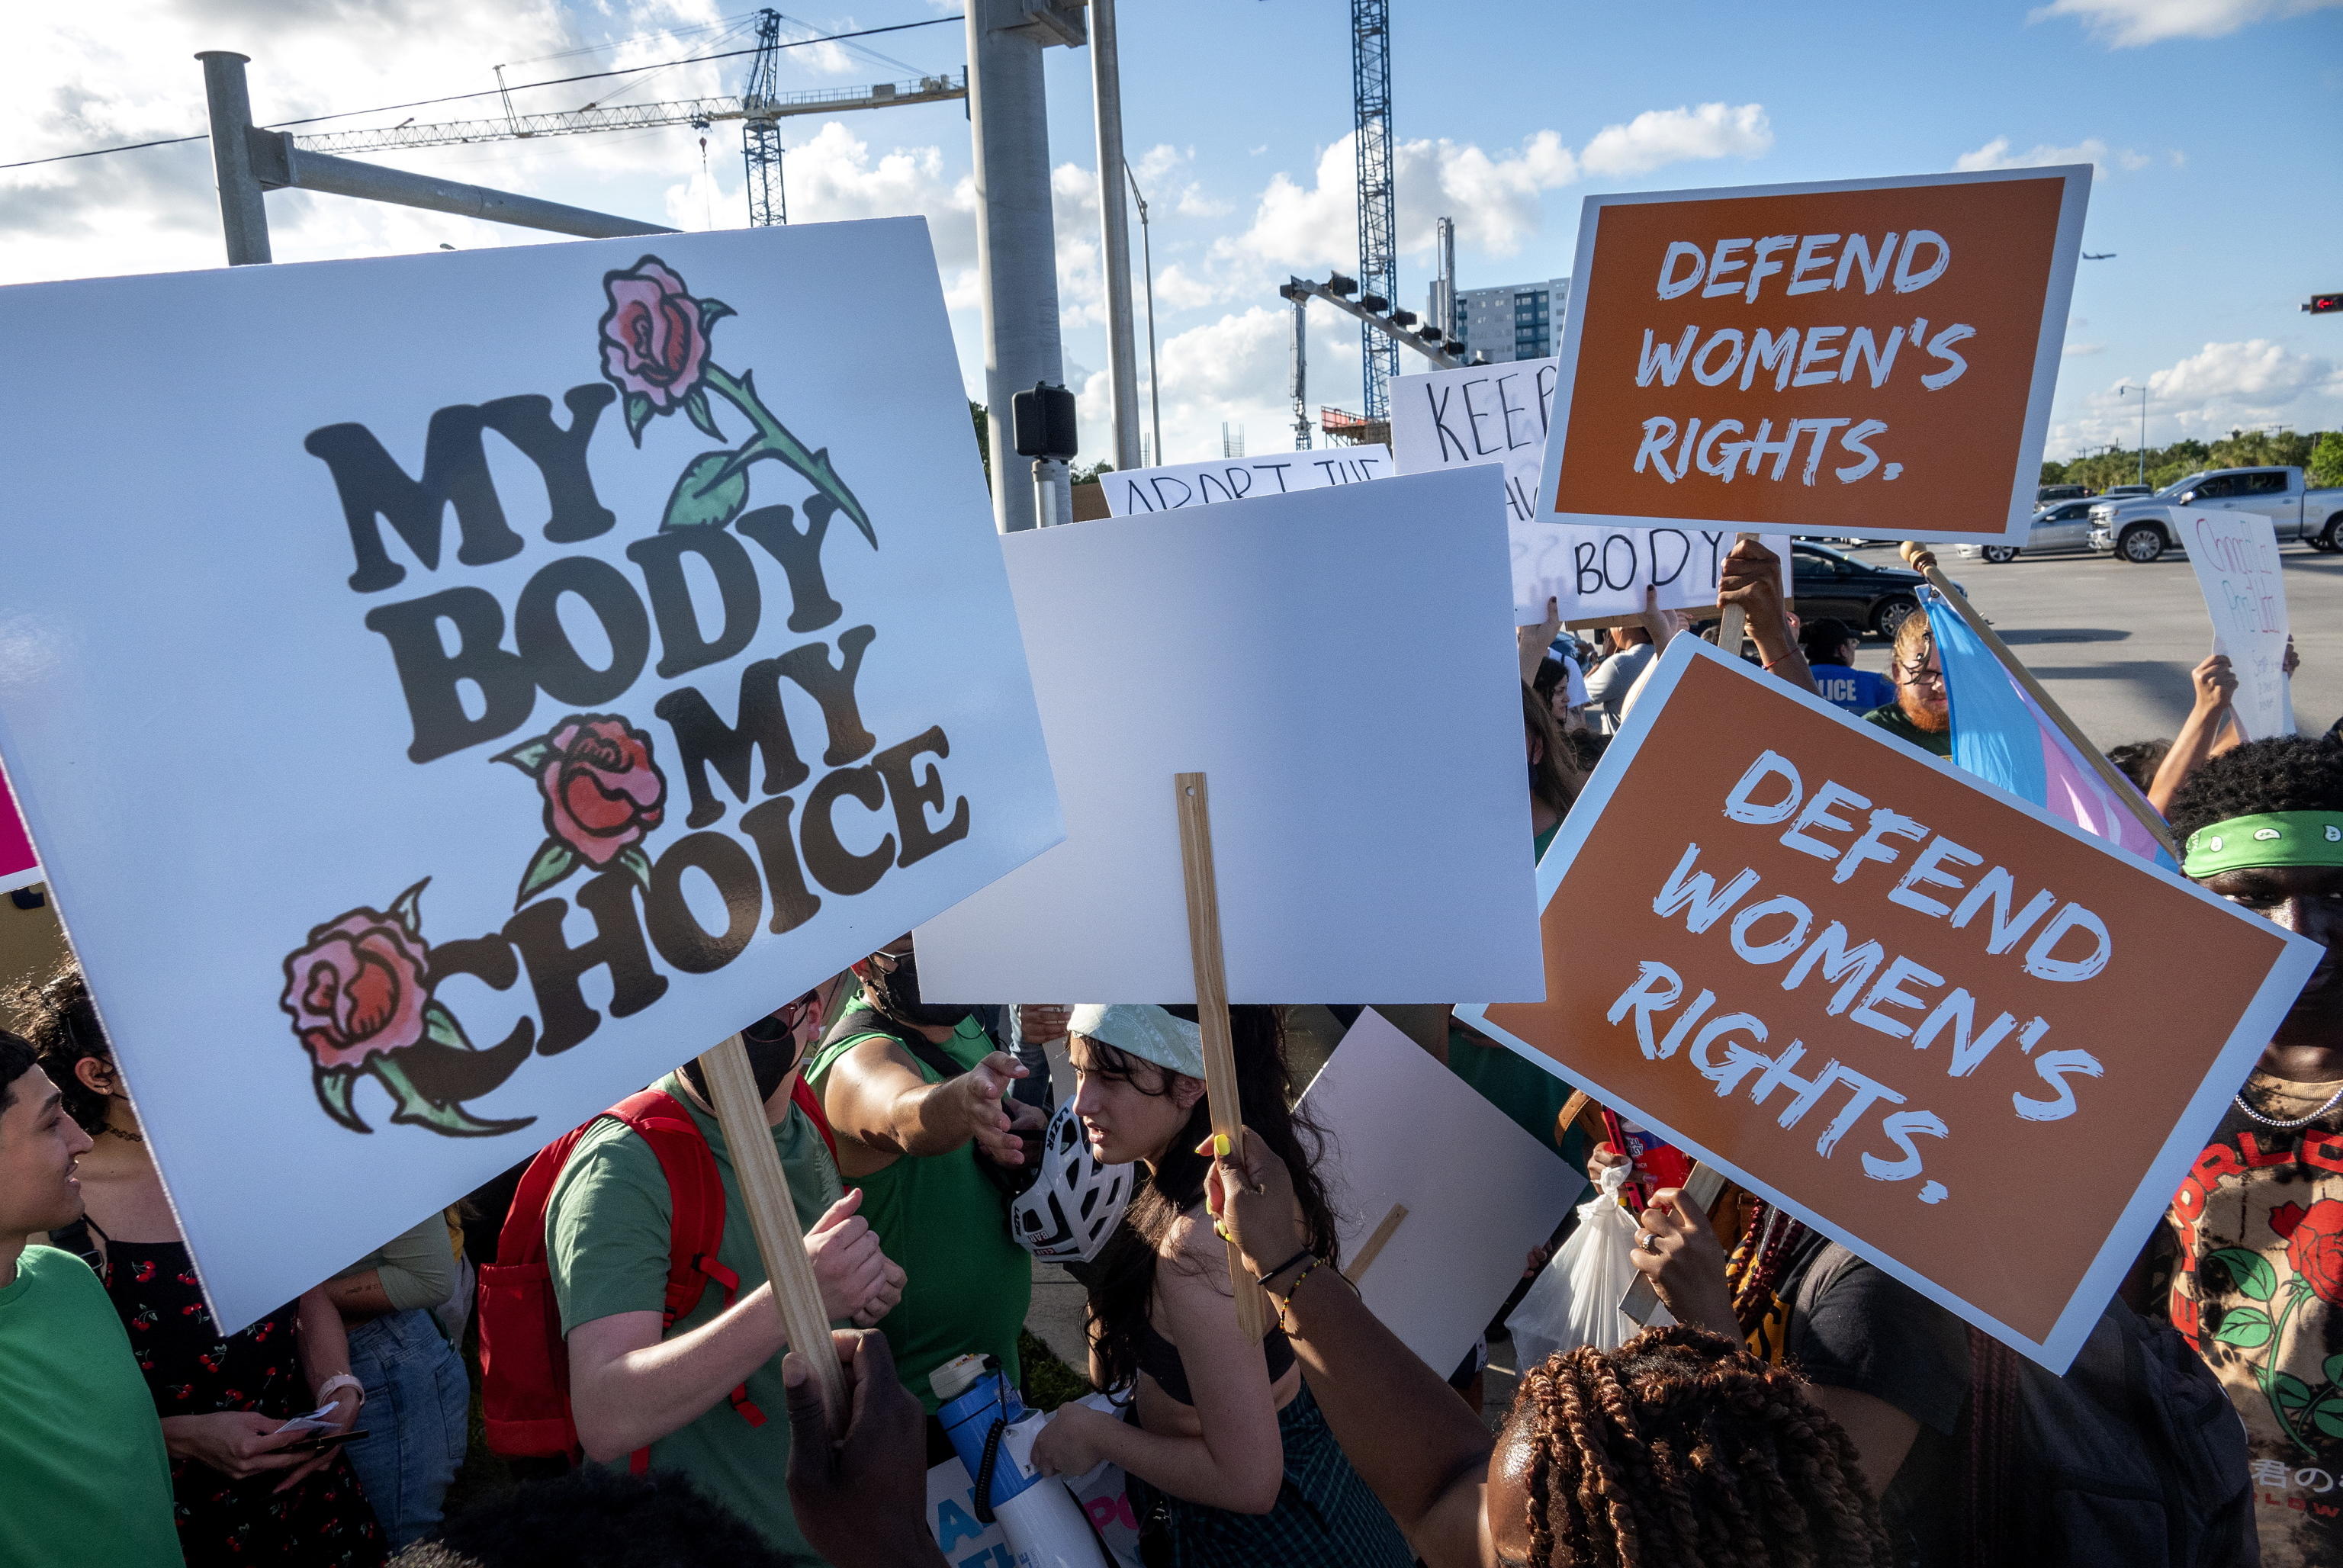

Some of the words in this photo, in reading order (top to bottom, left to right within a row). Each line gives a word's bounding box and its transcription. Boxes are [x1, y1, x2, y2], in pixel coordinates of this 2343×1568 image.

[1657, 229, 1950, 304] DEFEND
[1634, 316, 1977, 393] WOMEN'S
[304, 383, 616, 593] MY
[1634, 416, 1904, 487] RIGHTS.
[365, 493, 844, 764] BODY
[1574, 528, 1724, 596] BODY
[654, 624, 877, 829] MY
[1818, 678, 1857, 702] LICE
[393, 725, 970, 1104] CHOICE
[1721, 748, 2112, 983] DEFEND
[1651, 842, 2104, 1122] WOMEN'S
[1046, 1106, 1070, 1152] LAZER
[1606, 960, 1949, 1205] RIGHTS.
[2251, 1458, 2343, 1493] 君の
